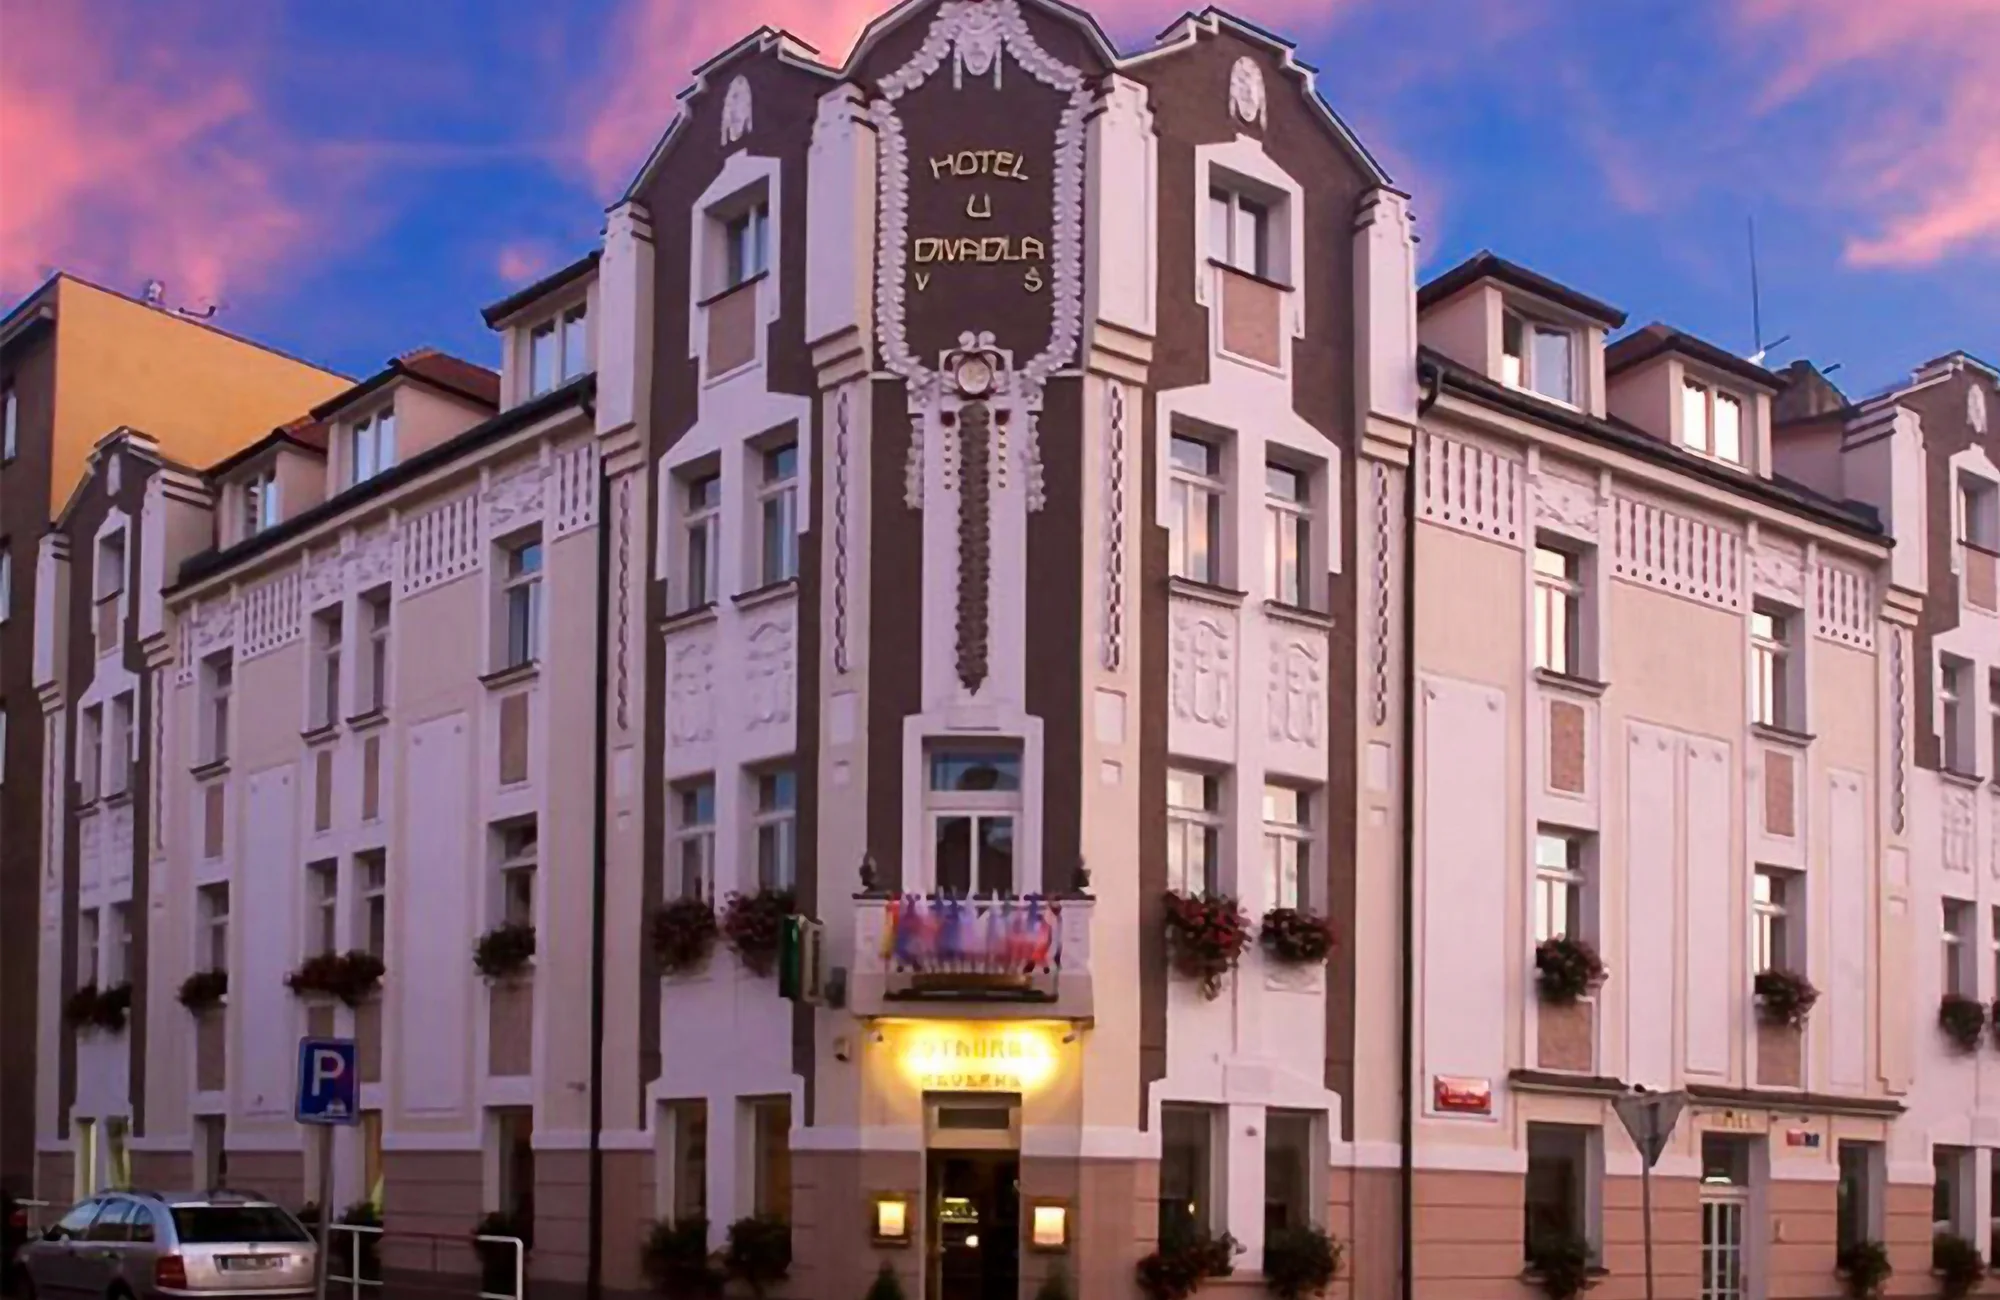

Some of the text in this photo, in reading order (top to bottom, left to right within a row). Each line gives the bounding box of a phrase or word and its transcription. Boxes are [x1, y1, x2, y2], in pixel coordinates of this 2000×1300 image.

[929, 149, 1029, 180] HOTEL
[966, 193, 992, 218] U
[914, 235, 1045, 262] DIVADLA
[914, 271, 931, 291] V
[311, 1048, 346, 1096] P
